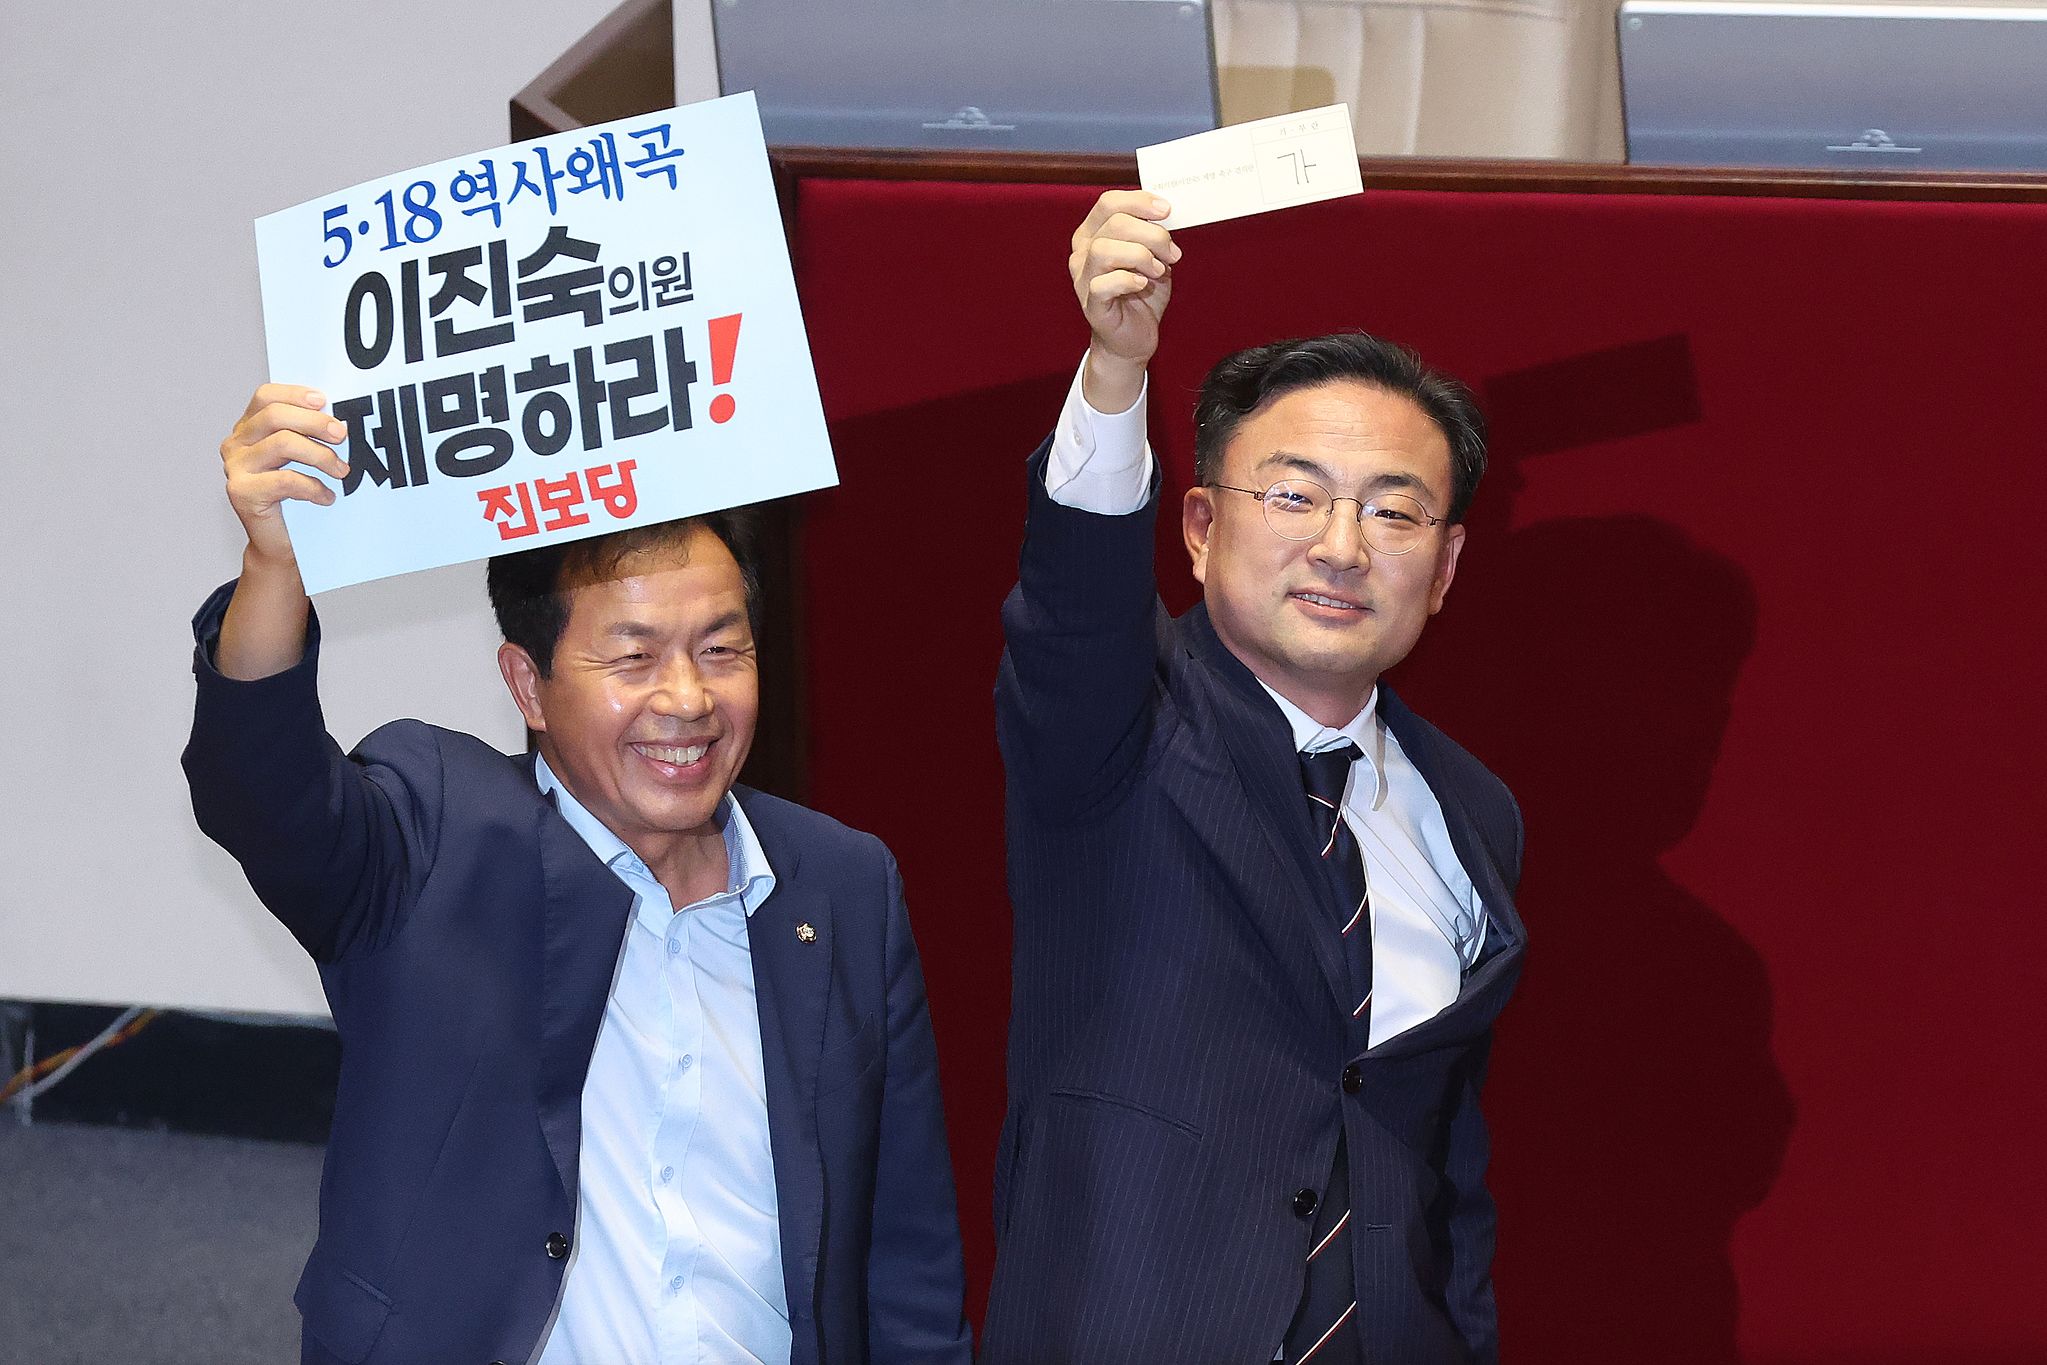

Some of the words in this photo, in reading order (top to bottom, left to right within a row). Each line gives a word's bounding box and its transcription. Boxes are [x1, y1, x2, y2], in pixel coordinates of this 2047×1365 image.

[450, 123, 685, 229] 역사왜곡
[1276, 148, 1317, 185] 가
[333, 313, 742, 497] 제명하라!
[477, 459, 638, 541] 진보당
